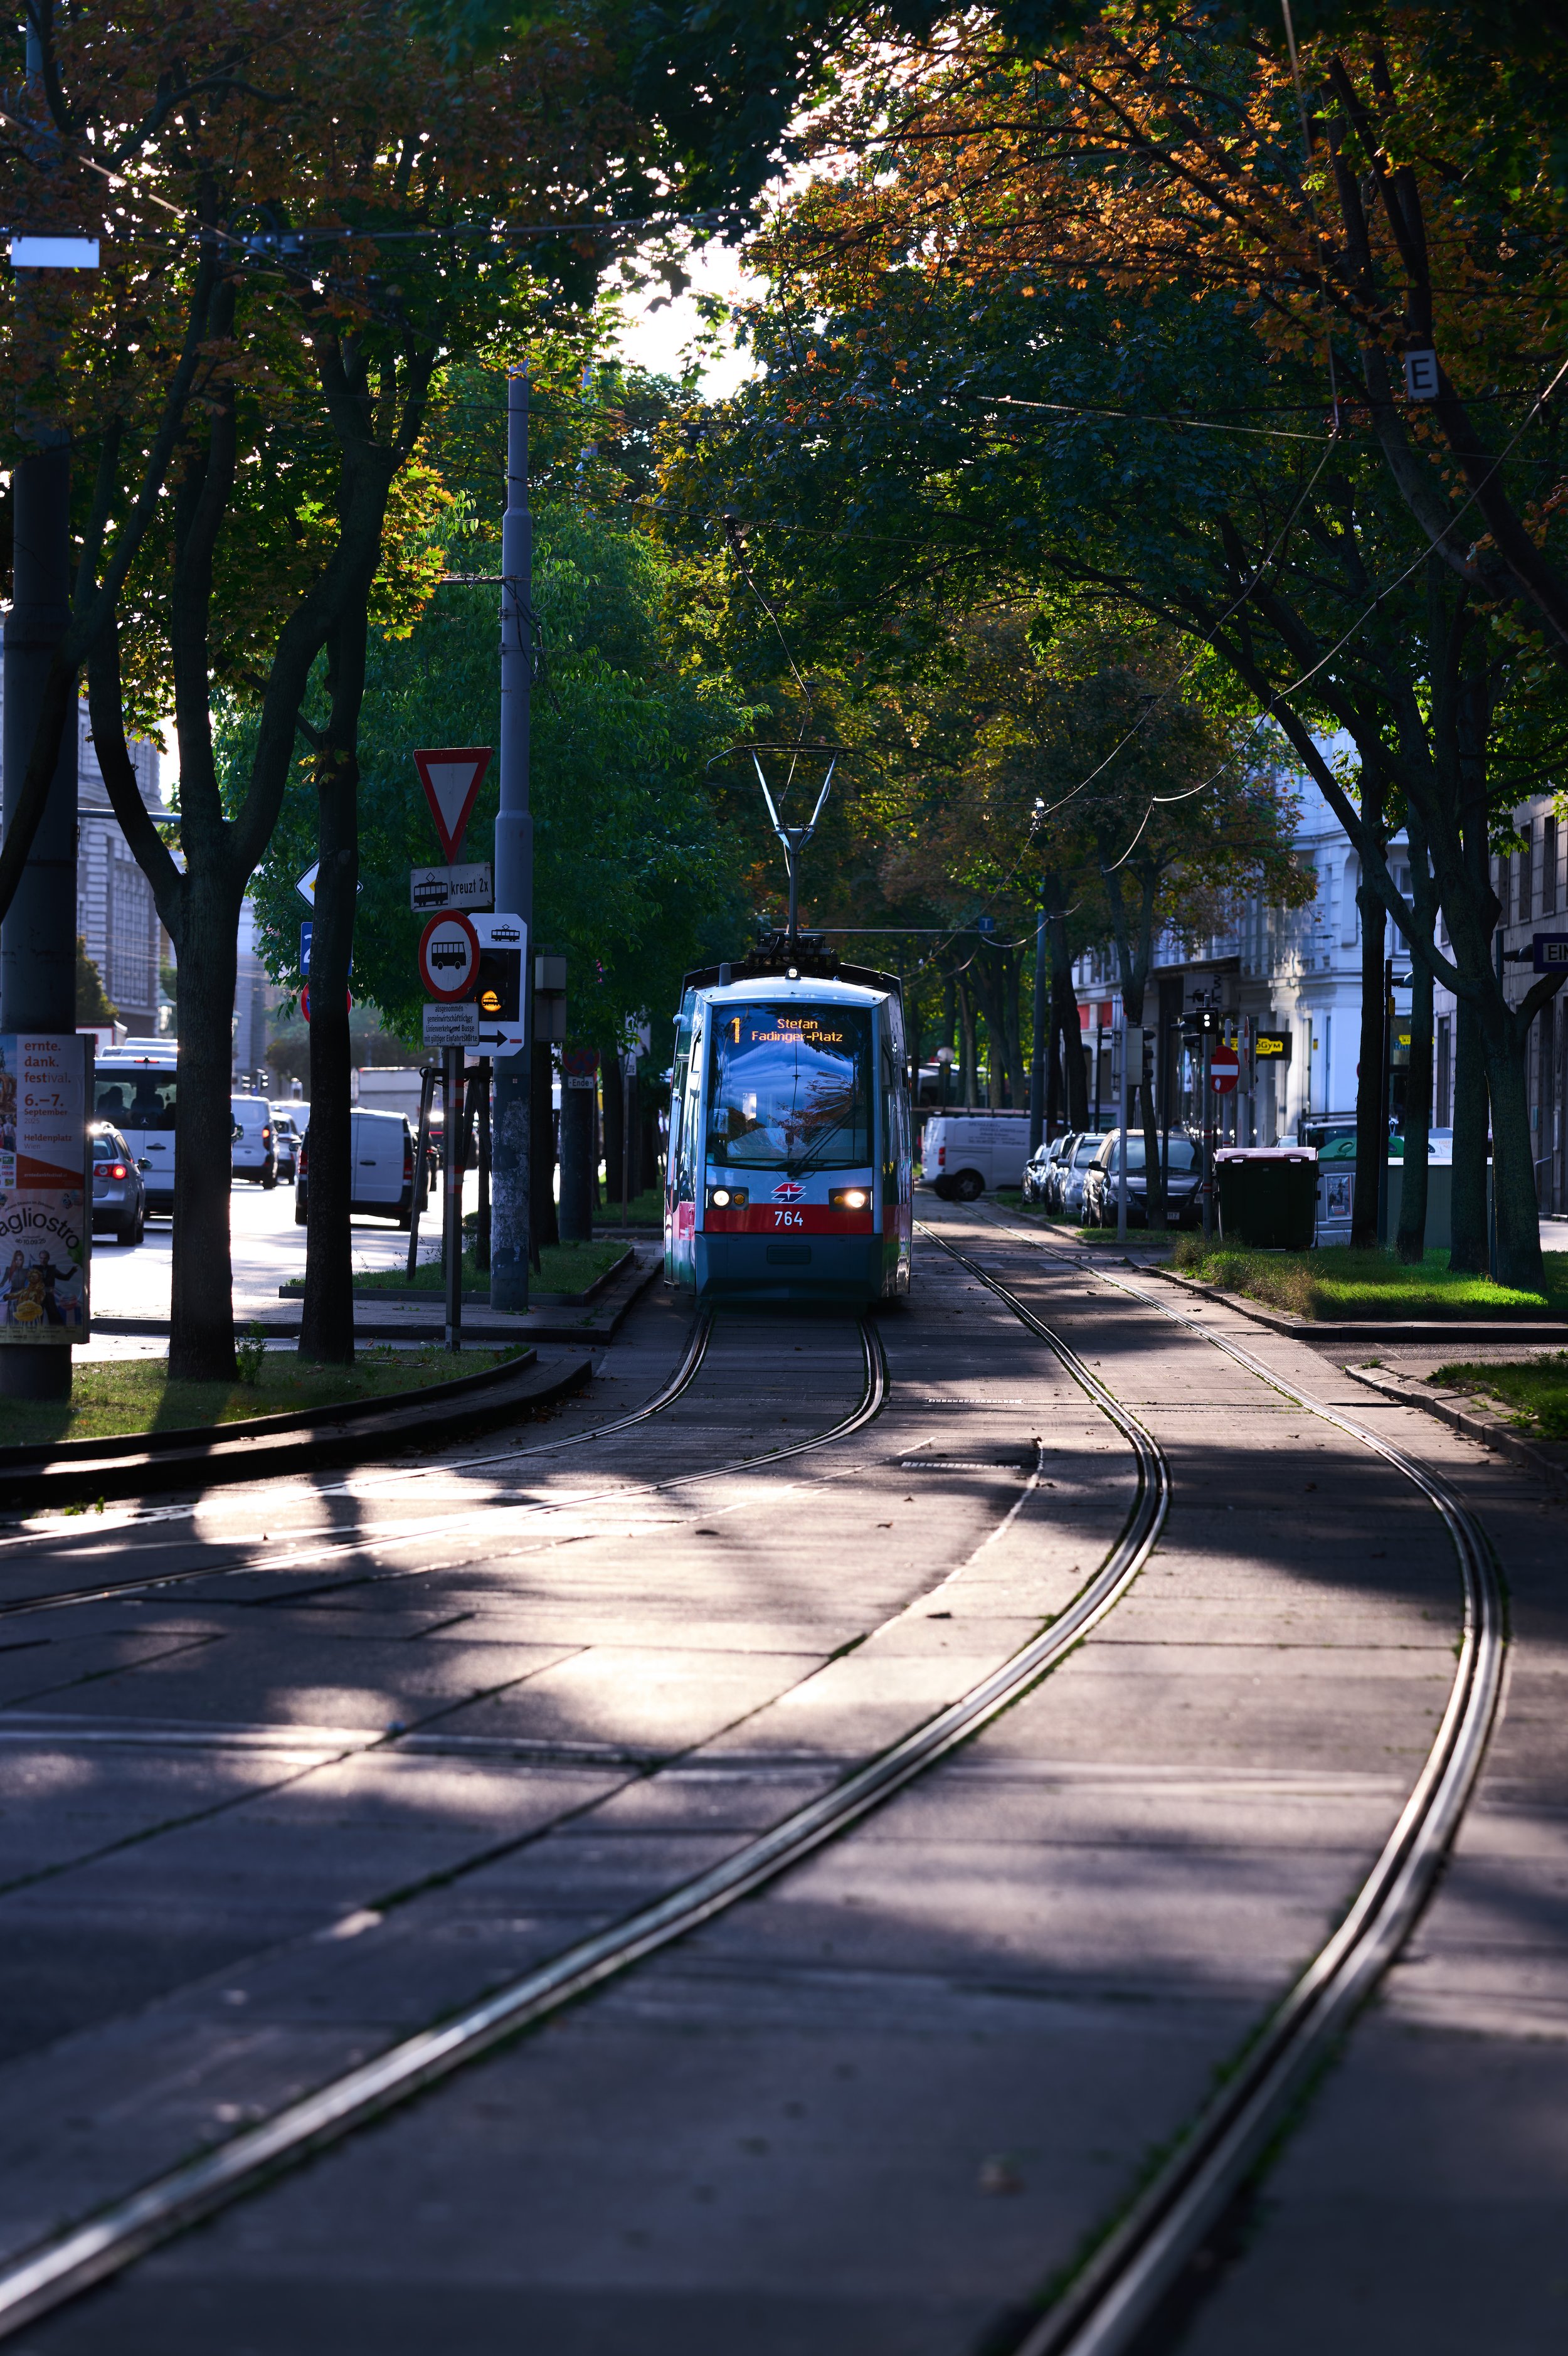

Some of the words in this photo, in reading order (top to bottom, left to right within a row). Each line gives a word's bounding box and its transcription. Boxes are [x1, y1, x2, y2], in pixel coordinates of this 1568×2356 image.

[1411, 358, 1433, 390] E
[451, 879, 475, 895] kreuzt
[479, 878, 489, 892] 2x
[982, 918, 991, 928] T
[777, 1019, 818, 1029] Stefan
[731, 1017, 740, 1043] 1
[751, 1031, 843, 1043] Fadinger-Platz
[24, 1041, 61, 1051] ernte.
[24, 1056, 59, 1067] dank.
[24, 1072, 71, 1083] festival.
[24, 1108, 68, 1117] September
[24, 1134, 72, 1142] Heldenplatz
[775, 1211, 803, 1226] 764
